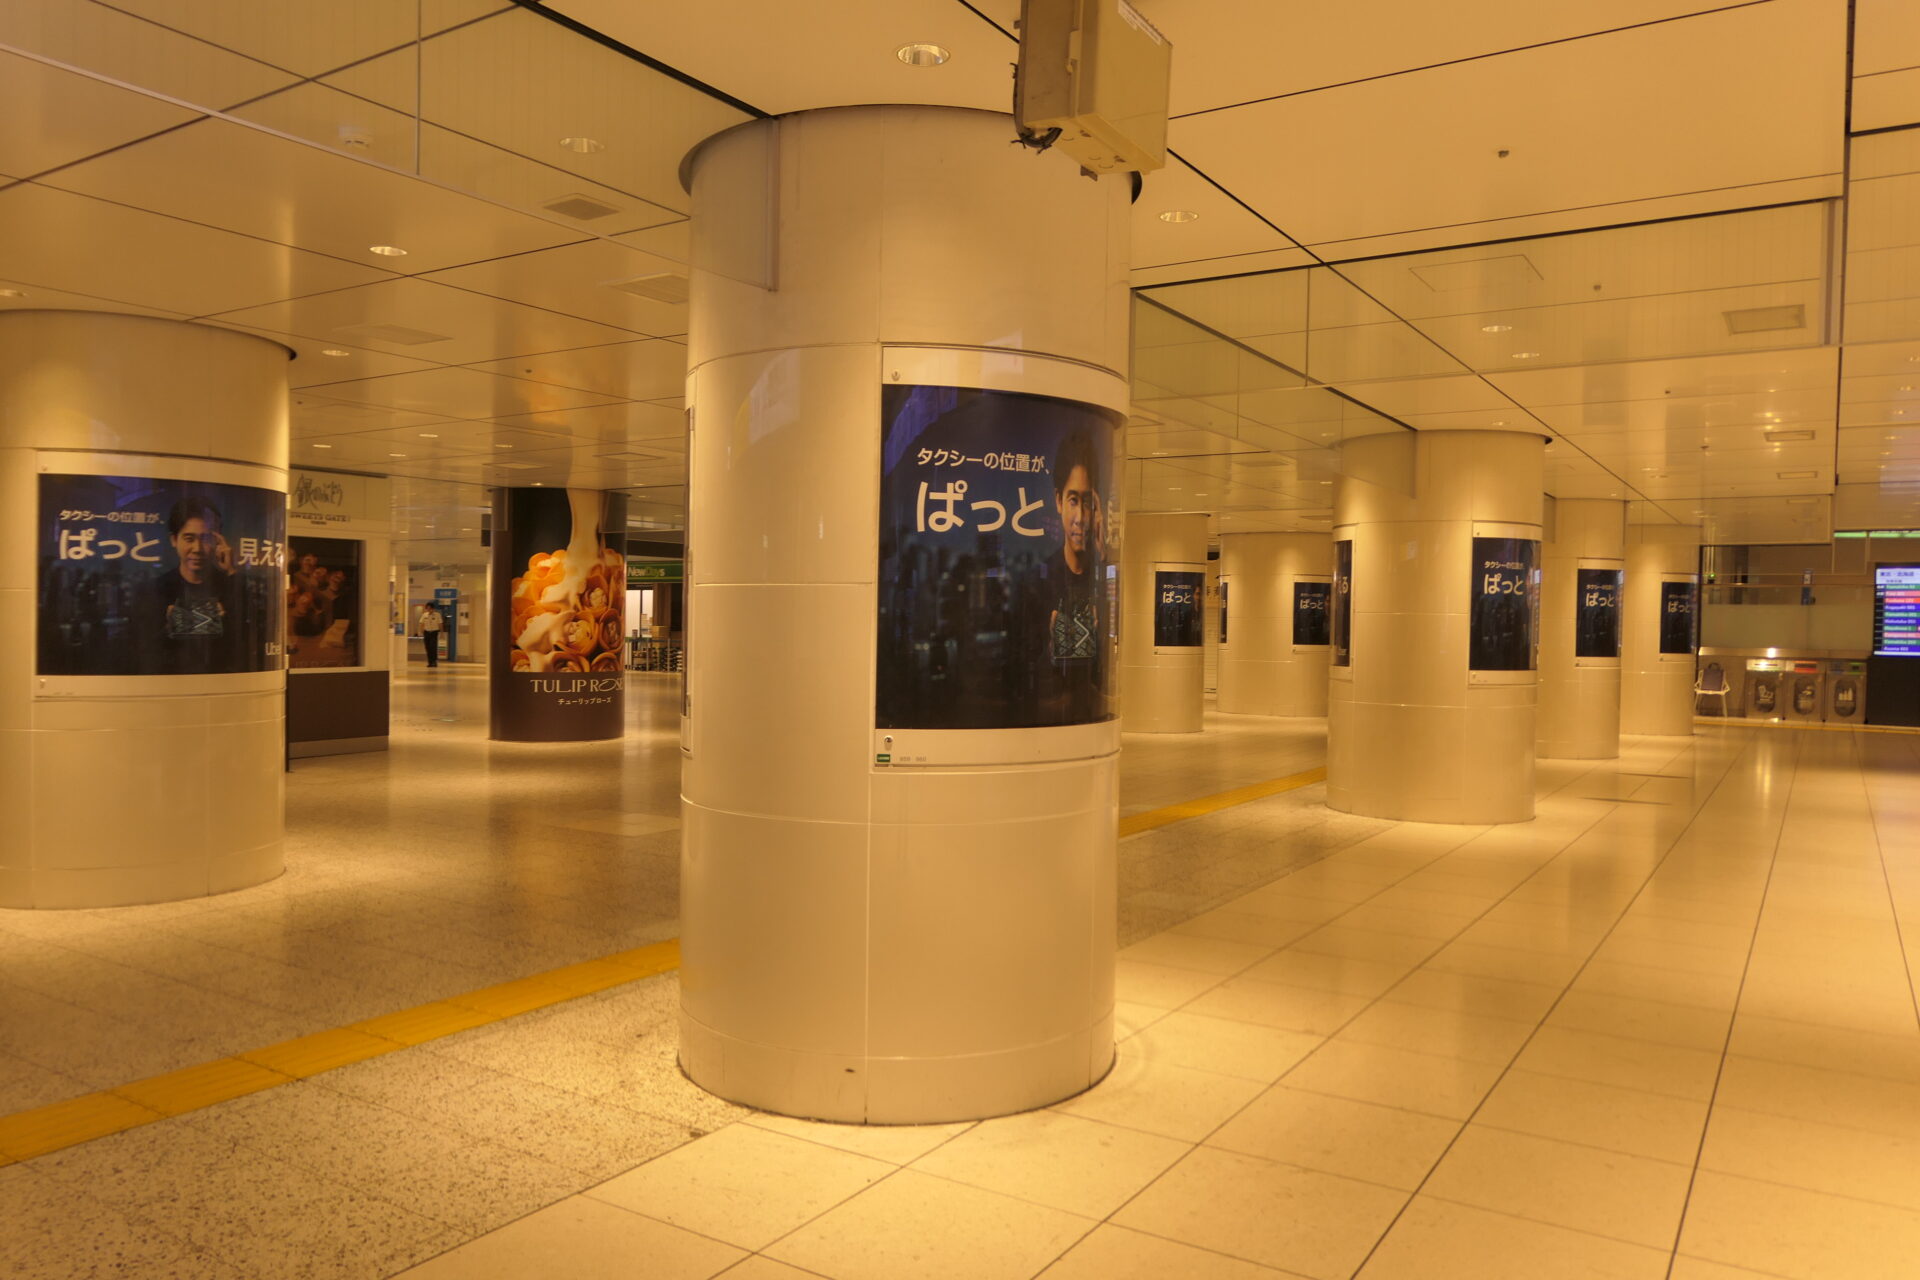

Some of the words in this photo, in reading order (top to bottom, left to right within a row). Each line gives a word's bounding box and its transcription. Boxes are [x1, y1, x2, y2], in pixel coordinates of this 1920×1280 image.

[917, 447, 1050, 475] タクシーの位置が、
[916, 480, 1045, 537] ぱっと
[59, 528, 161, 562] ぱっと
[1484, 573, 1524, 596] ぱっと
[1162, 591, 1192, 604] ぱっと
[1586, 592, 1615, 607] ぱっと
[530, 679, 587, 693] TULIP
